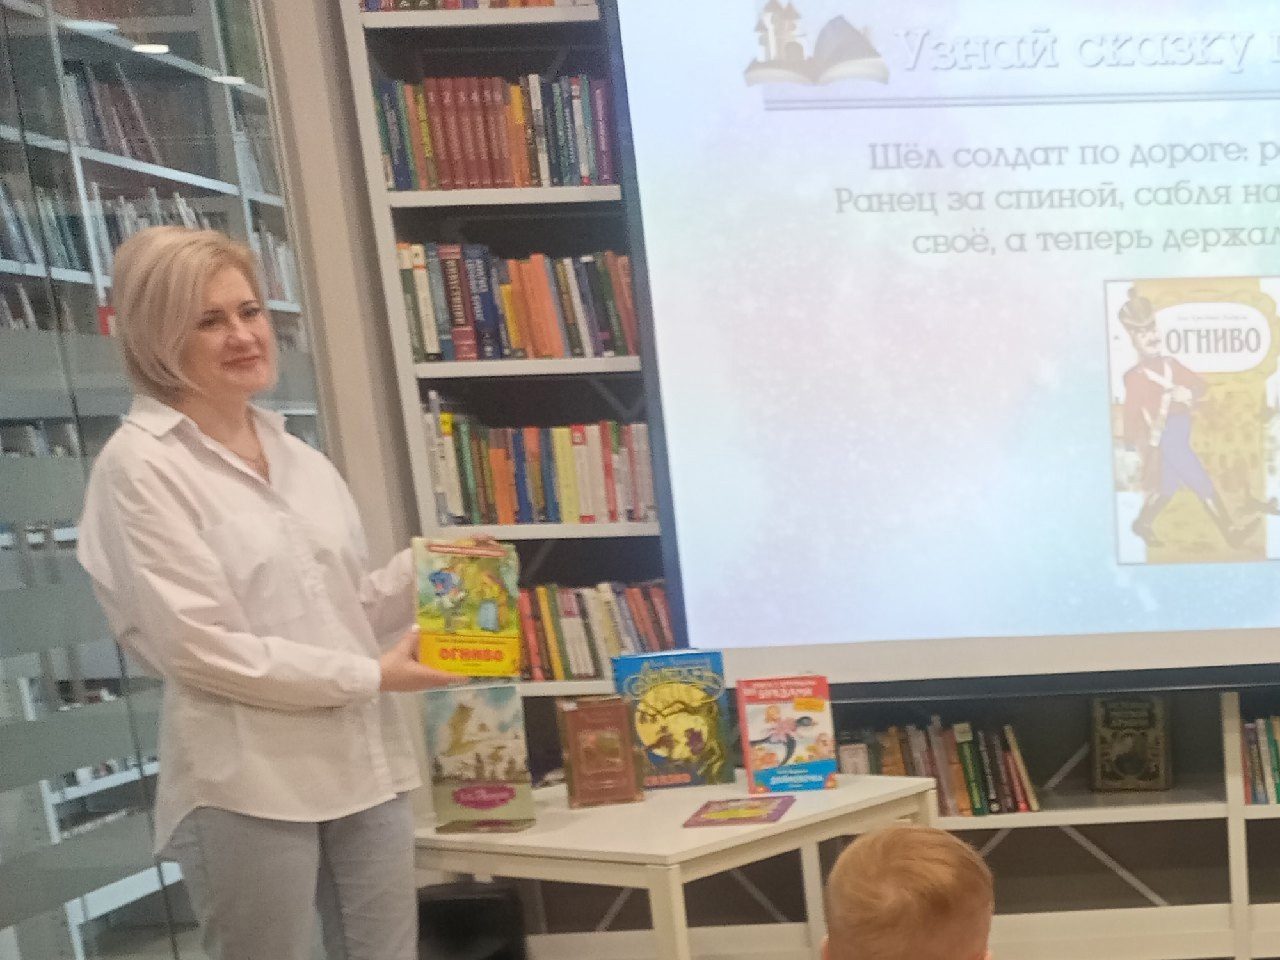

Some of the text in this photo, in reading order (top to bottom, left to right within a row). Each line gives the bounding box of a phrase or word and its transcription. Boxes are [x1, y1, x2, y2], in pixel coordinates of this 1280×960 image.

[898, 27, 1060, 71] Узнай
[1078, 29, 1255, 74] сказку
[867, 142, 943, 170] Шёл
[953, 144, 1070, 171] солдат
[1079, 142, 1121, 165] по
[1130, 141, 1249, 168] дороге:
[834, 187, 938, 216] Ранец
[947, 189, 984, 213] за
[994, 181, 1126, 213] спиной,
[1134, 181, 1232, 208] сабля
[912, 227, 996, 257] своё,
[1005, 231, 1027, 253] а
[1036, 227, 1154, 256] теперь
[1166, 327, 1261, 354] ОГНИВО
